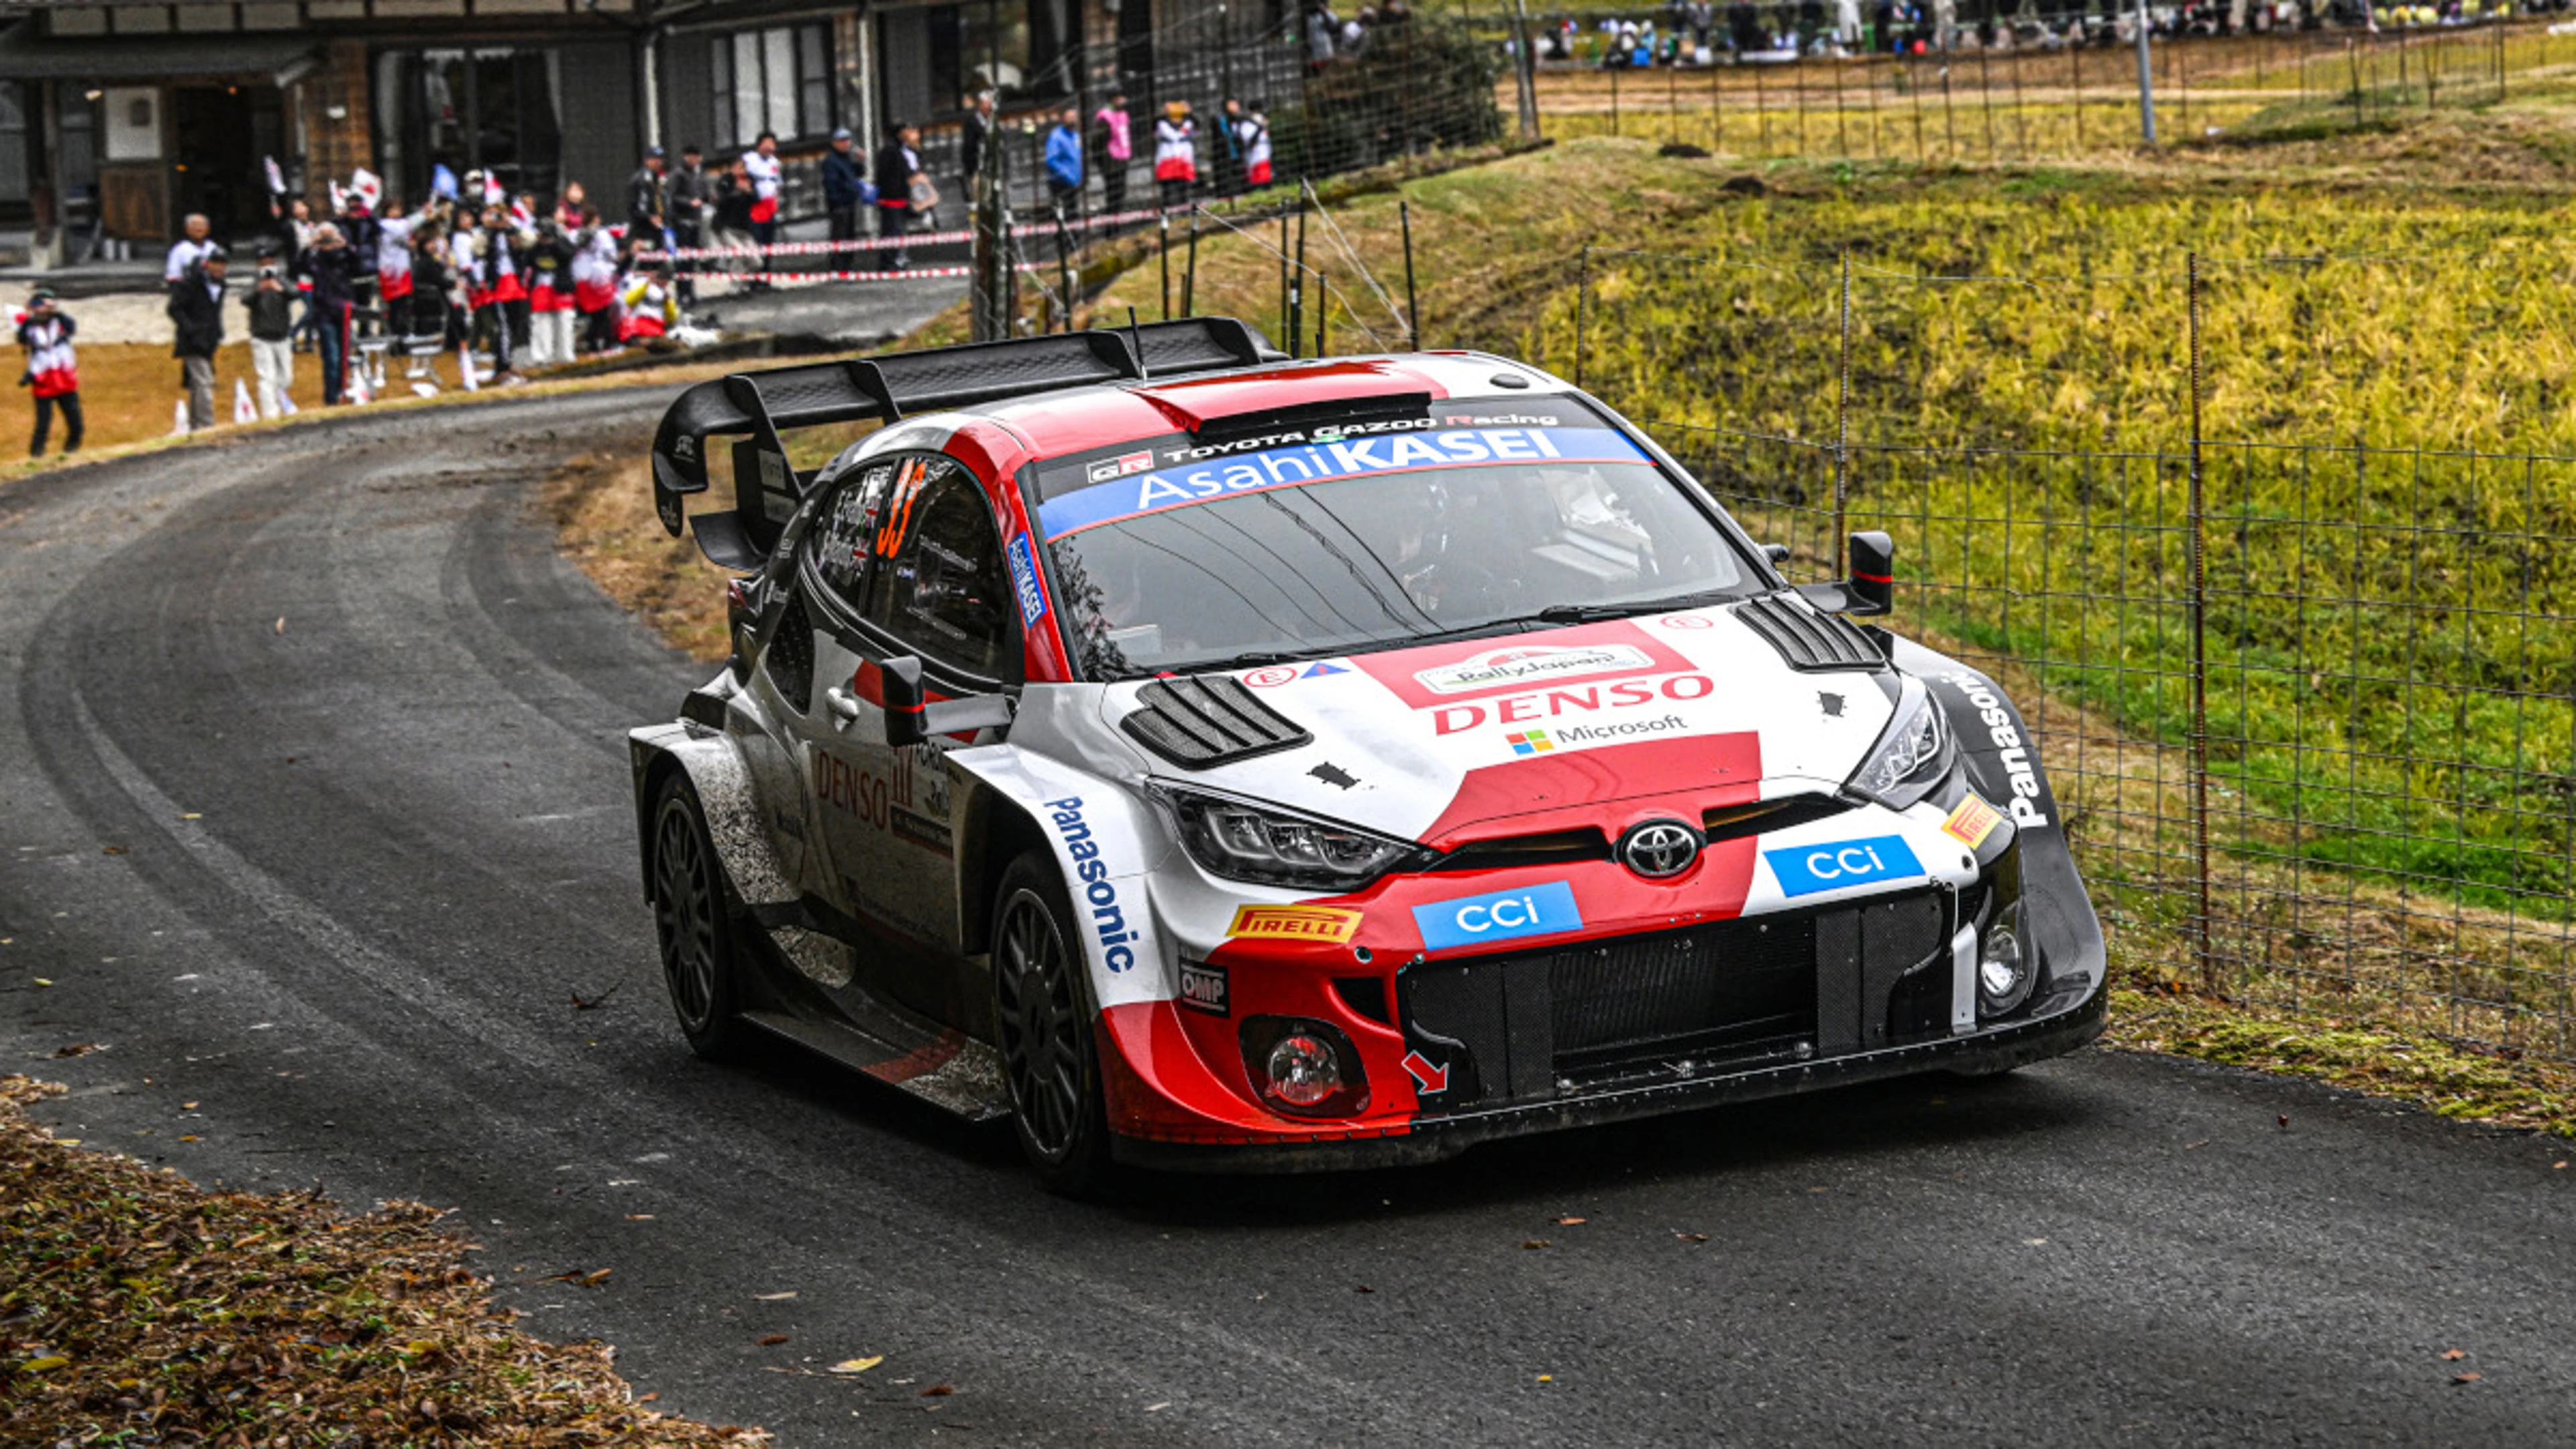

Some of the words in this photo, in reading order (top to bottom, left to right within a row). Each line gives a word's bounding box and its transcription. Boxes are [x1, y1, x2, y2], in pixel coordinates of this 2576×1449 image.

[1091, 457, 1151, 482] GR
[1164, 431, 1305, 462] TOYOTA
[1313, 417, 1437, 437] GAZOO
[1444, 413, 1558, 427] Racing
[1138, 429, 1562, 509] AsahiKASEI
[1433, 674, 1715, 736] DENSO
[1556, 714, 1688, 743] Microsoft
[818, 749, 888, 830] DENSO
[1042, 796, 1139, 973] Panasonic
[1236, 909, 1350, 936] PIRELLI
[1181, 972, 1225, 1004] OMP
